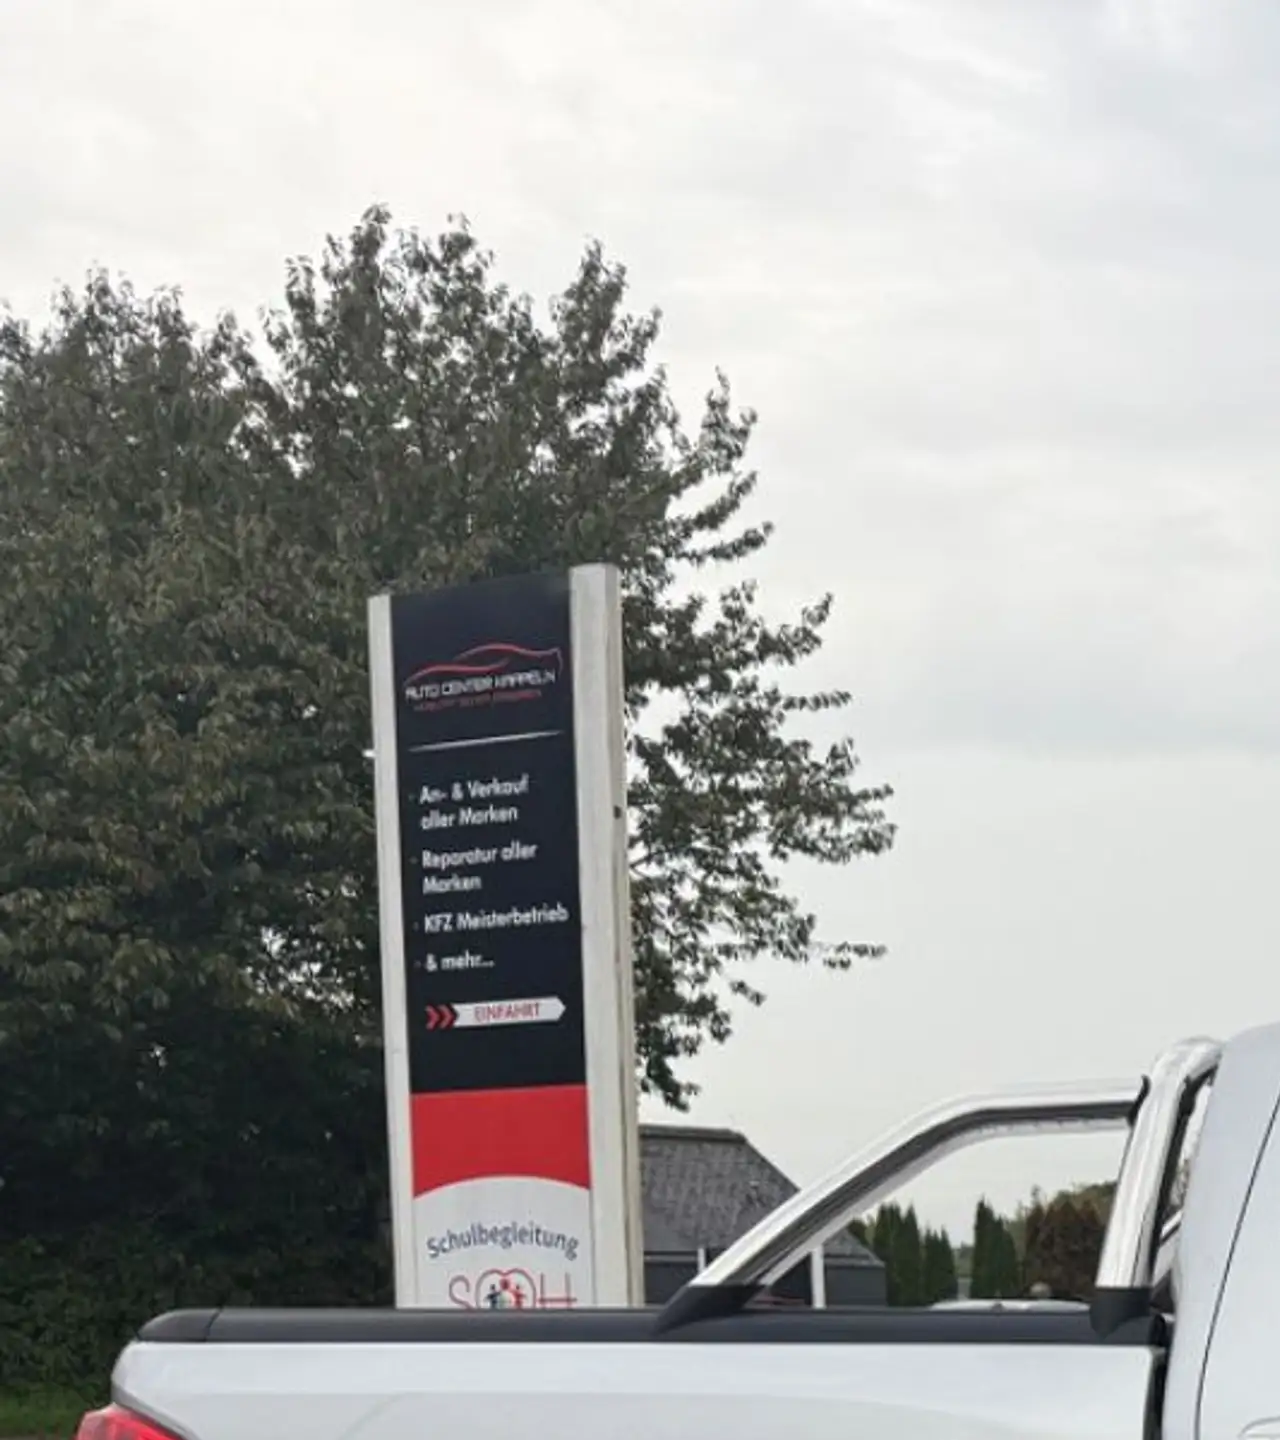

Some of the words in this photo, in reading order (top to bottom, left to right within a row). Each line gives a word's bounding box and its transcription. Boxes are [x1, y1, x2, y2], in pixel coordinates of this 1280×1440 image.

[404, 683, 440, 700] AUTO
[441, 676, 494, 696] CENTER
[420, 785, 448, 804] An-
[452, 782, 463, 800] &
[468, 773, 529, 798] Verkauf
[420, 809, 455, 830] aller
[459, 805, 518, 826] Marken
[422, 846, 498, 871] Reparatur
[501, 840, 537, 860] aller
[422, 875, 482, 895] Marken
[424, 912, 453, 933] KFZ
[457, 902, 569, 930] Meisterbetrieb
[426, 954, 438, 972] &
[474, 1002, 540, 1023] EINFAHRT
[426, 1221, 579, 1261] Schulbegleitung
